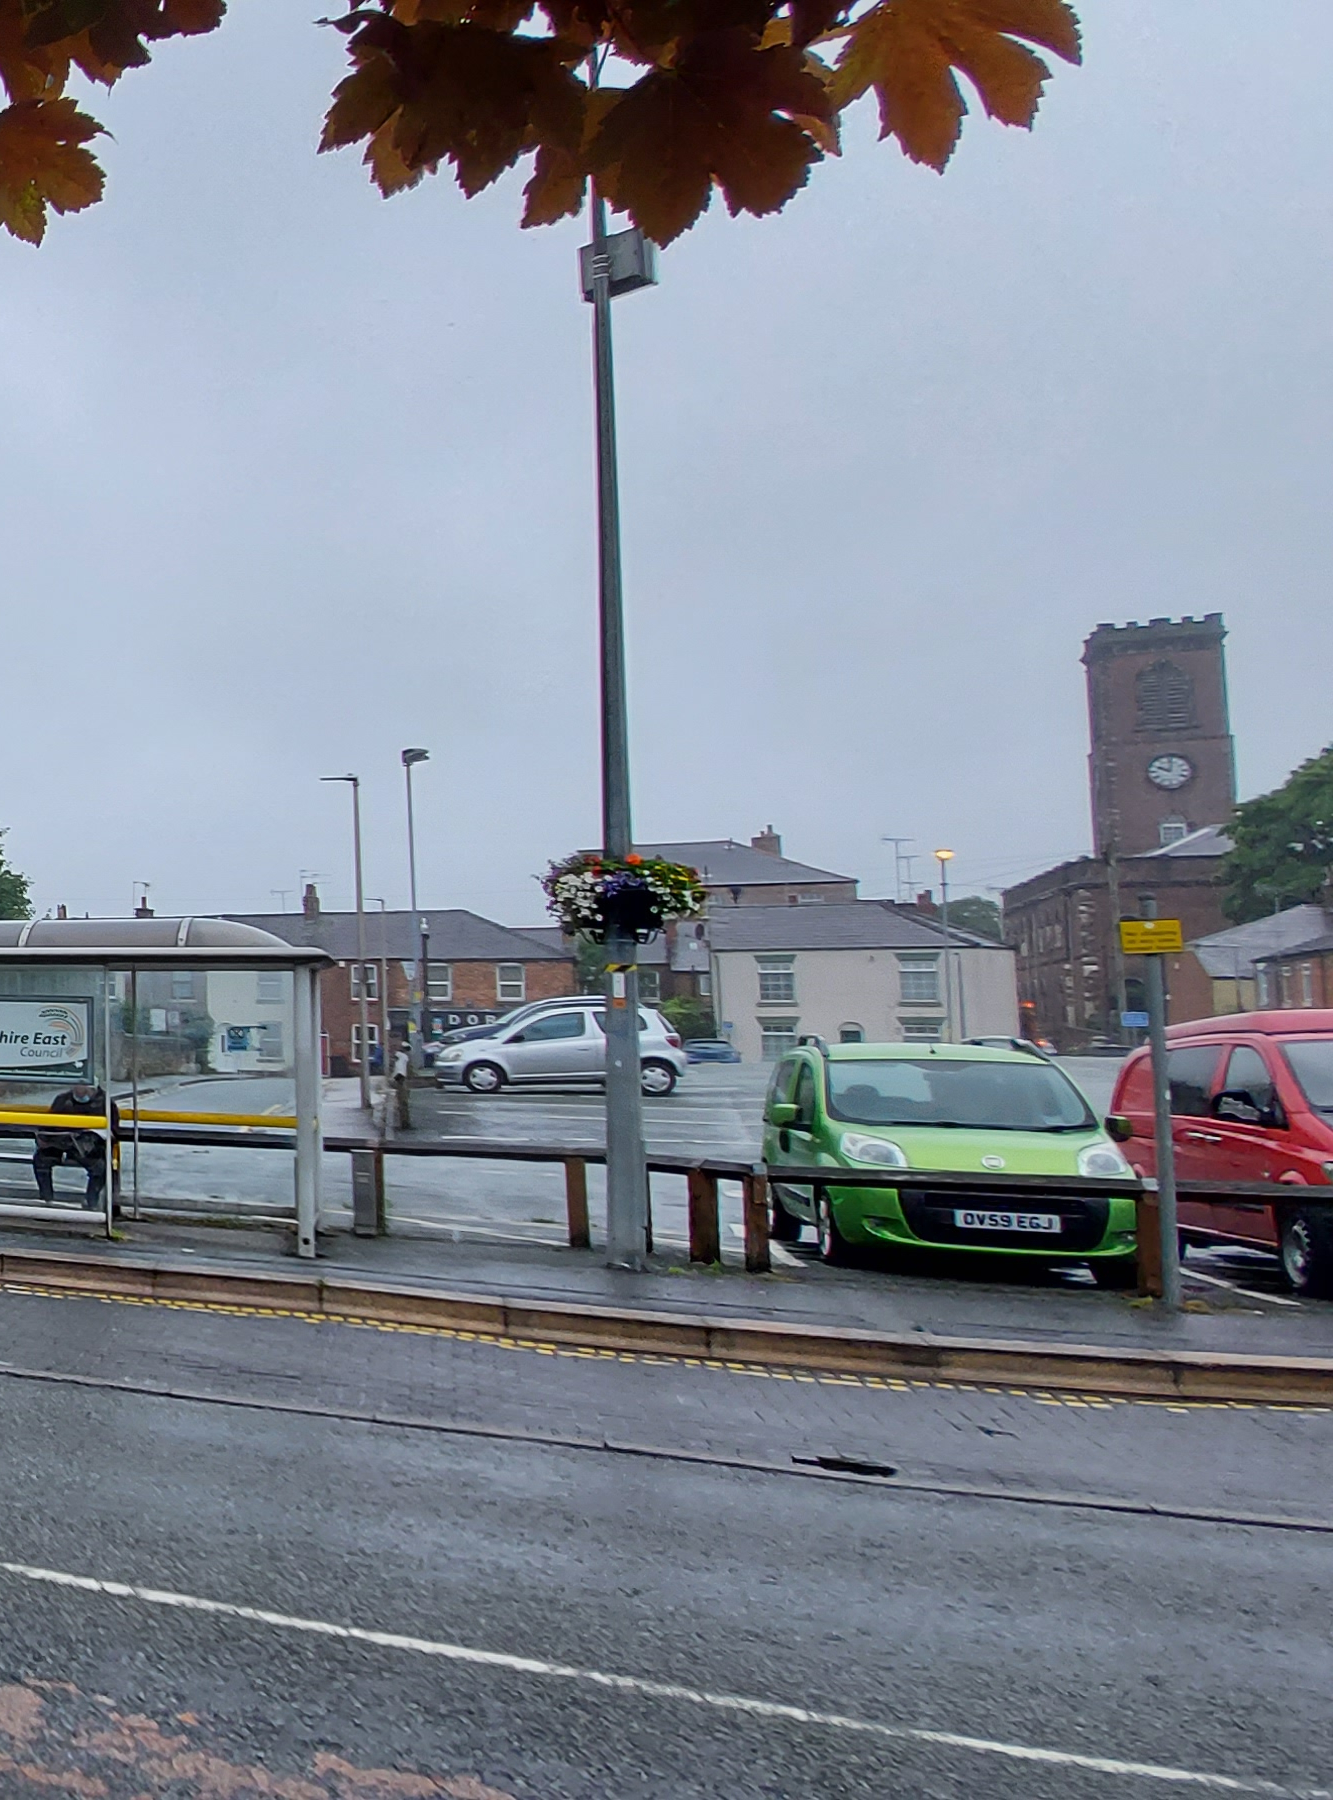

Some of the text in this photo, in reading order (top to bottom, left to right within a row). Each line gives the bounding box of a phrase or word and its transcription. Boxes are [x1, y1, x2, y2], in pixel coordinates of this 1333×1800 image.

[33, 1032, 68, 1046] East
[19, 1046, 64, 1058] Council
[963, 1212, 1053, 1230] OV59 EGJ
